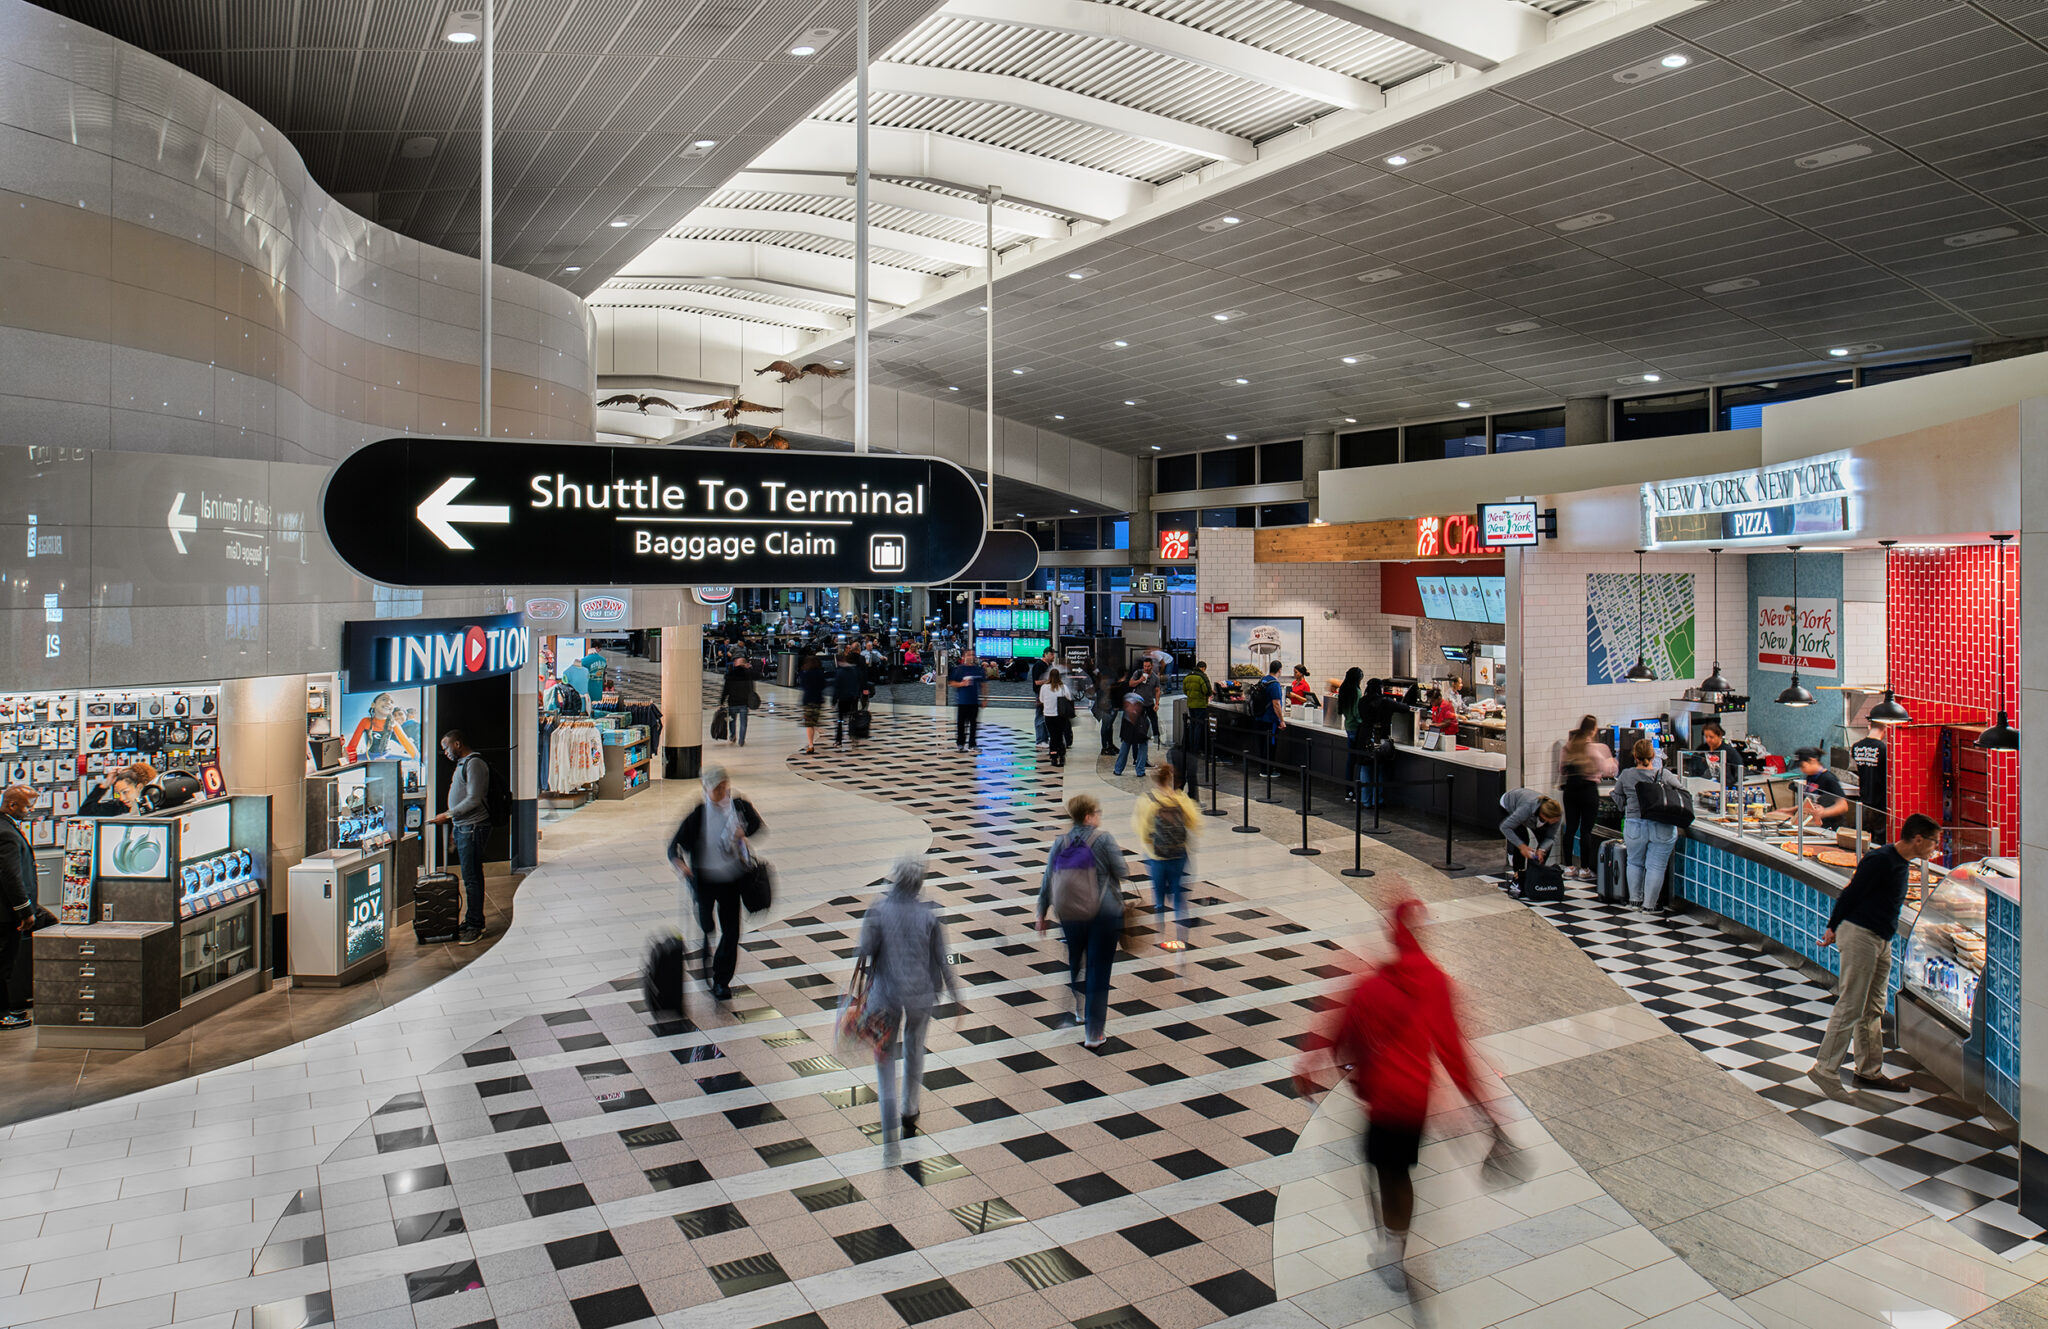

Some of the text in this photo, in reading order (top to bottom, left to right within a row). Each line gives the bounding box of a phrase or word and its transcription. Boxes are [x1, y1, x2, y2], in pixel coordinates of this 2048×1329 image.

[529, 473, 925, 516] Shuttle To Terminal
[1653, 459, 1846, 513] NEW YORK NEW YORK
[1487, 511, 1533, 523] New York
[1487, 522, 1533, 534] New York
[1734, 511, 1773, 537] PIZZA
[634, 529, 837, 562] Baggage Claim
[1759, 609, 1835, 635] New York
[391, 626, 529, 682] INMOTION
[1759, 632, 1834, 658] New York
[1781, 655, 1809, 667] PIZZA
[349, 896, 381, 927] JOY
[946, 954, 955, 965] 8
